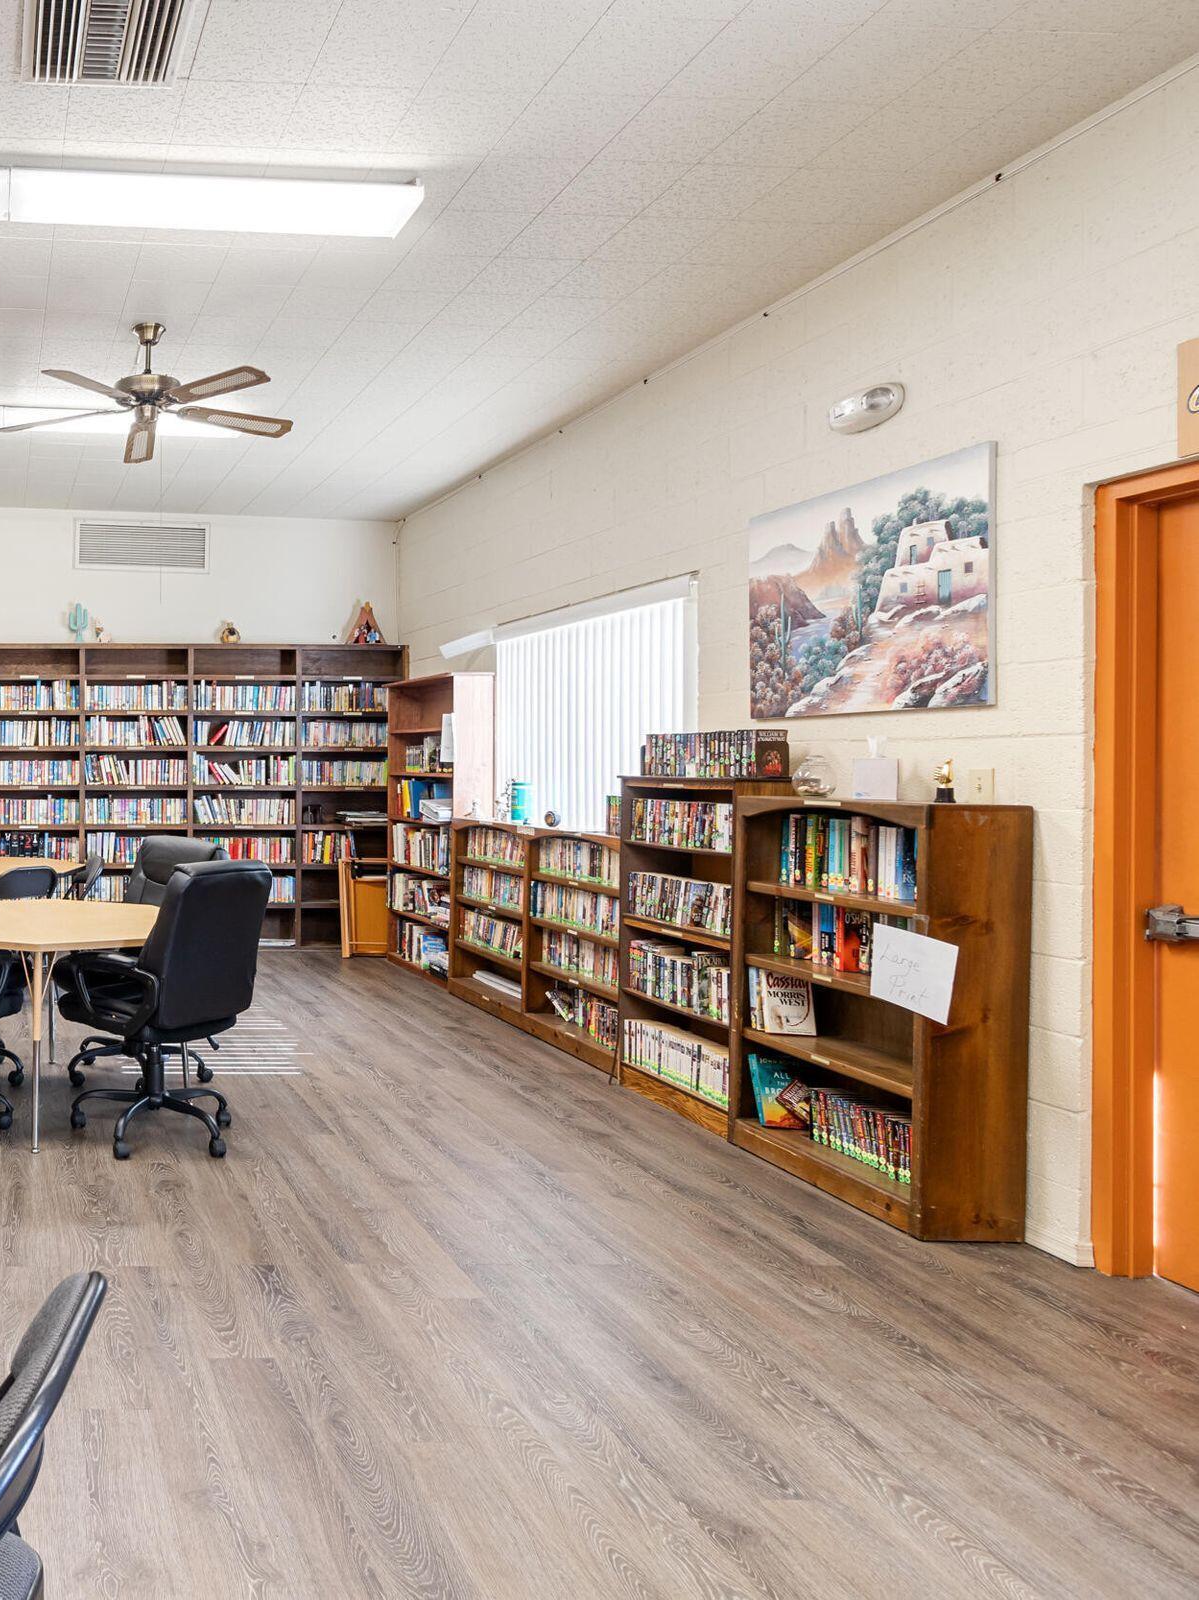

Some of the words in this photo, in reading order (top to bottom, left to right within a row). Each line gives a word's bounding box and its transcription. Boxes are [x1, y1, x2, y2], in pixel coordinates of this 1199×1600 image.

[880, 943, 920, 977] Large
[767, 990, 806, 999] MORRIS
[780, 998, 805, 1006] WEST
